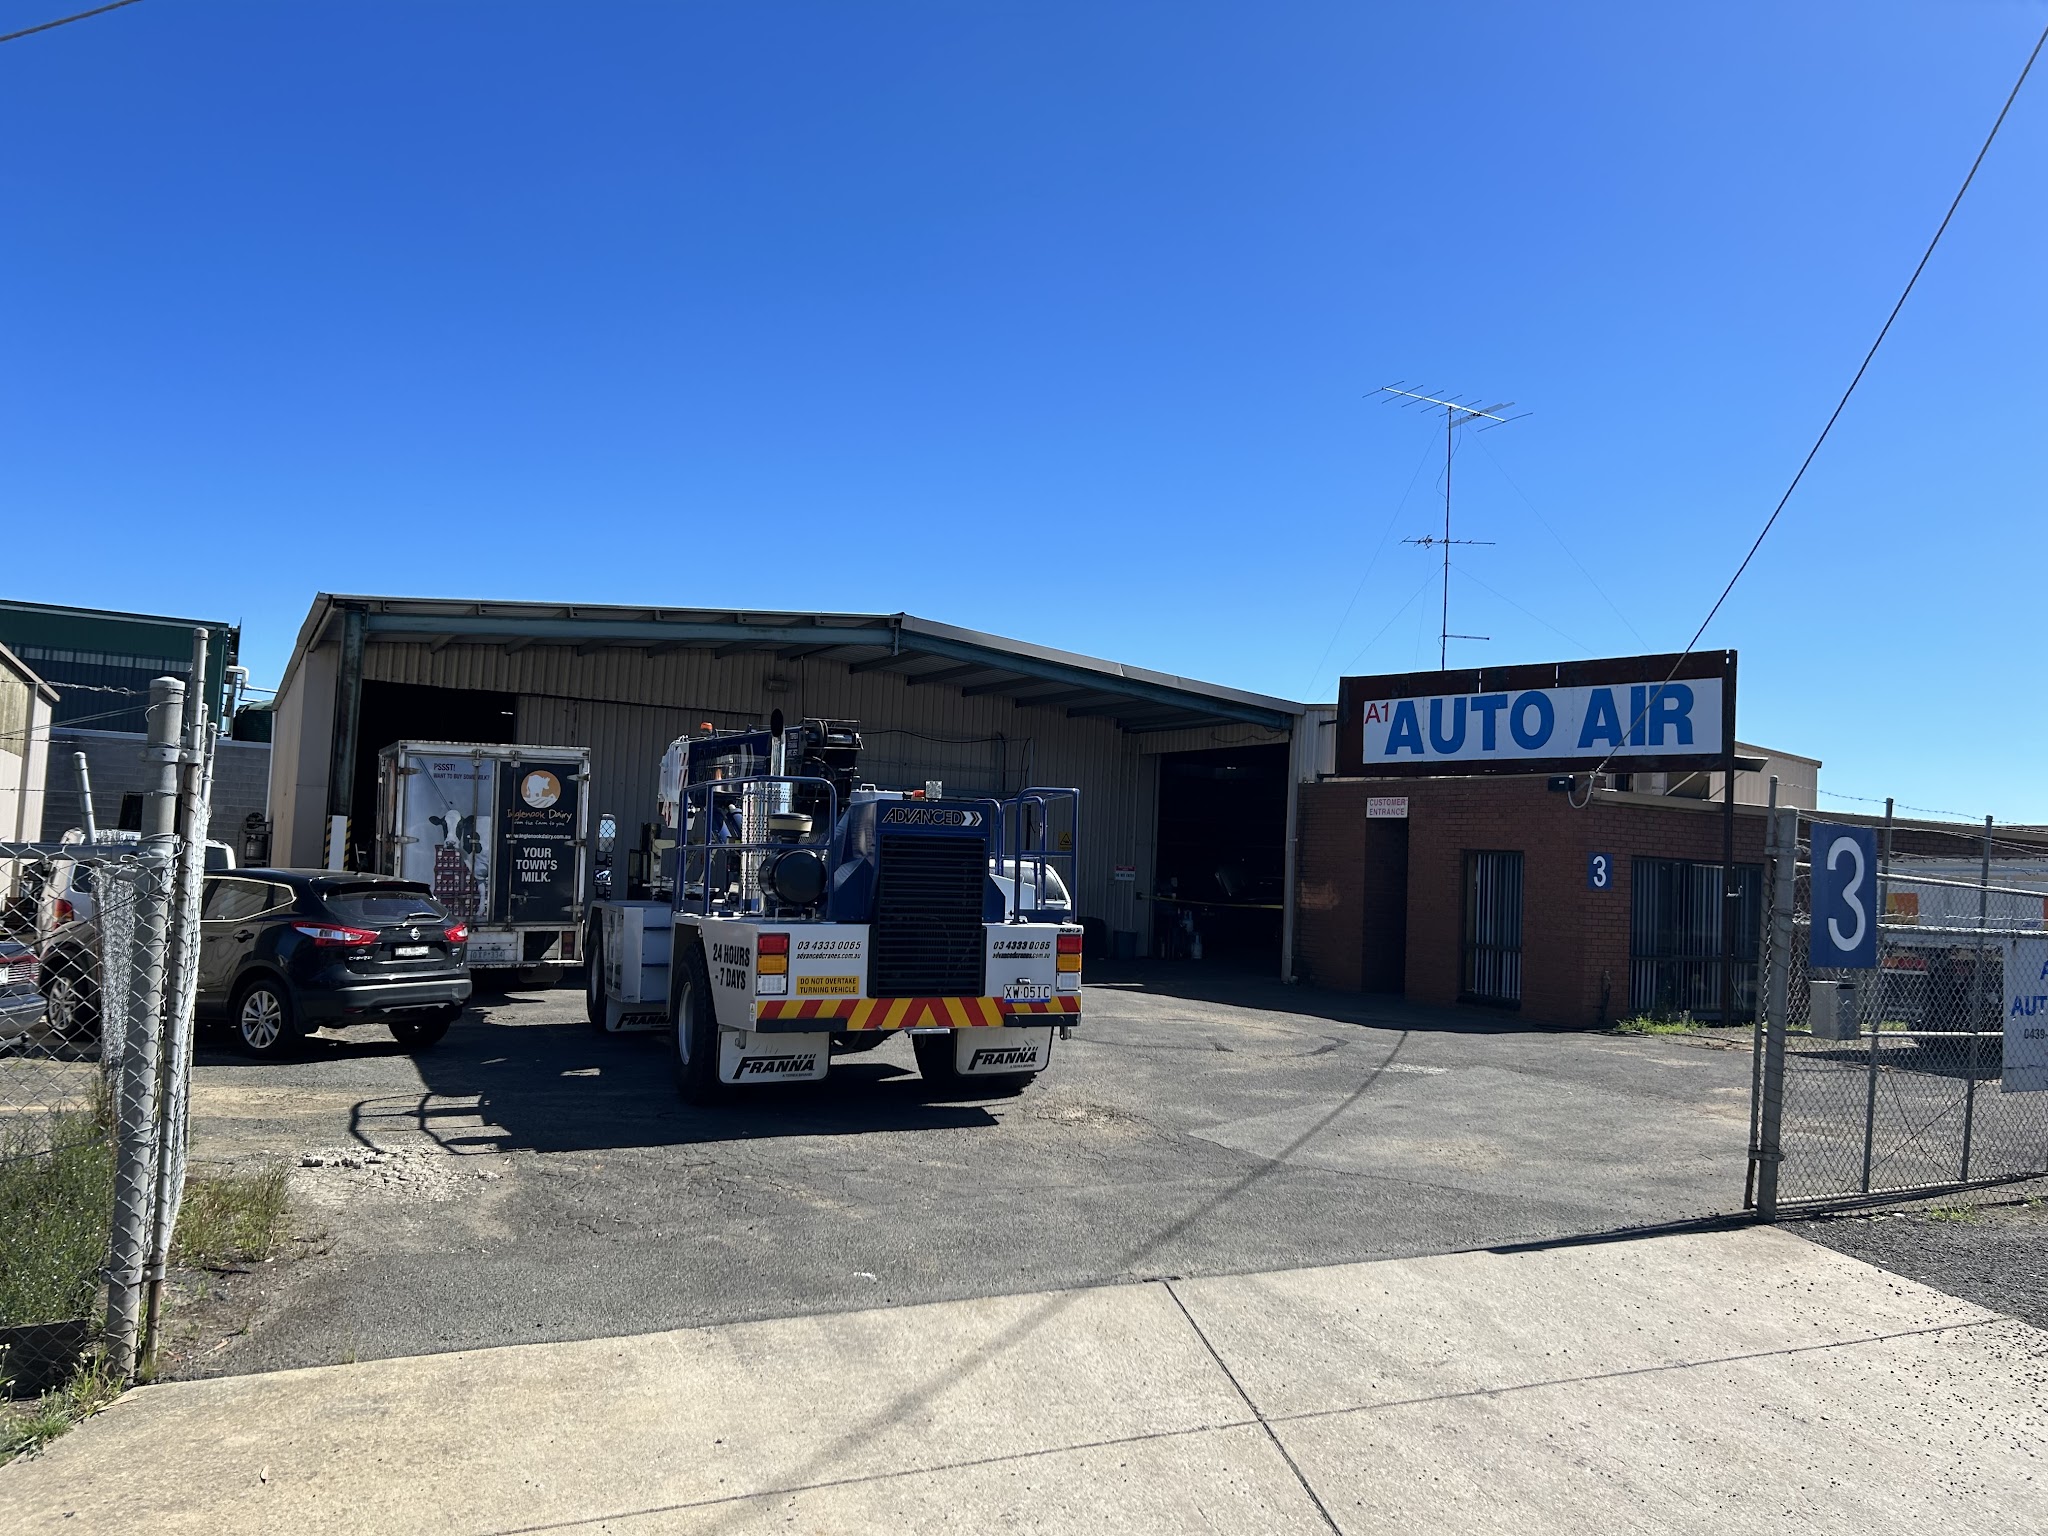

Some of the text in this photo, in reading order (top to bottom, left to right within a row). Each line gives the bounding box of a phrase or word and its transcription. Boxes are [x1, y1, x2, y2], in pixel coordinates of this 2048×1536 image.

[1364, 683, 1695, 755] A1 AUTO AIR
[433, 763, 456, 771] PSSST!
[1370, 798, 1406, 806] CUSTOMER
[548, 809, 573, 824] Dairy
[881, 807, 963, 826] ADVANCED
[1370, 808, 1405, 816] ENTRANCE
[522, 847, 552, 858] YOUR
[515, 859, 558, 870] TOWN'S
[521, 871, 551, 882] MILK.
[1592, 855, 1607, 887] 3
[1827, 836, 1866, 951] 3
[797, 941, 862, 950] 03 4333 0065
[993, 941, 1051, 950] 03 4333 0065
[712, 943, 751, 968] 24 HOURS
[796, 952, 862, 960] advancedcranes.com.au
[720, 967, 725, 986] 7
[726, 969, 746, 990] DAYS
[825, 977, 857, 985] OVERTAKE
[968, 1046, 1039, 1071] FRANNA
[732, 1054, 816, 1080] FRANNA
